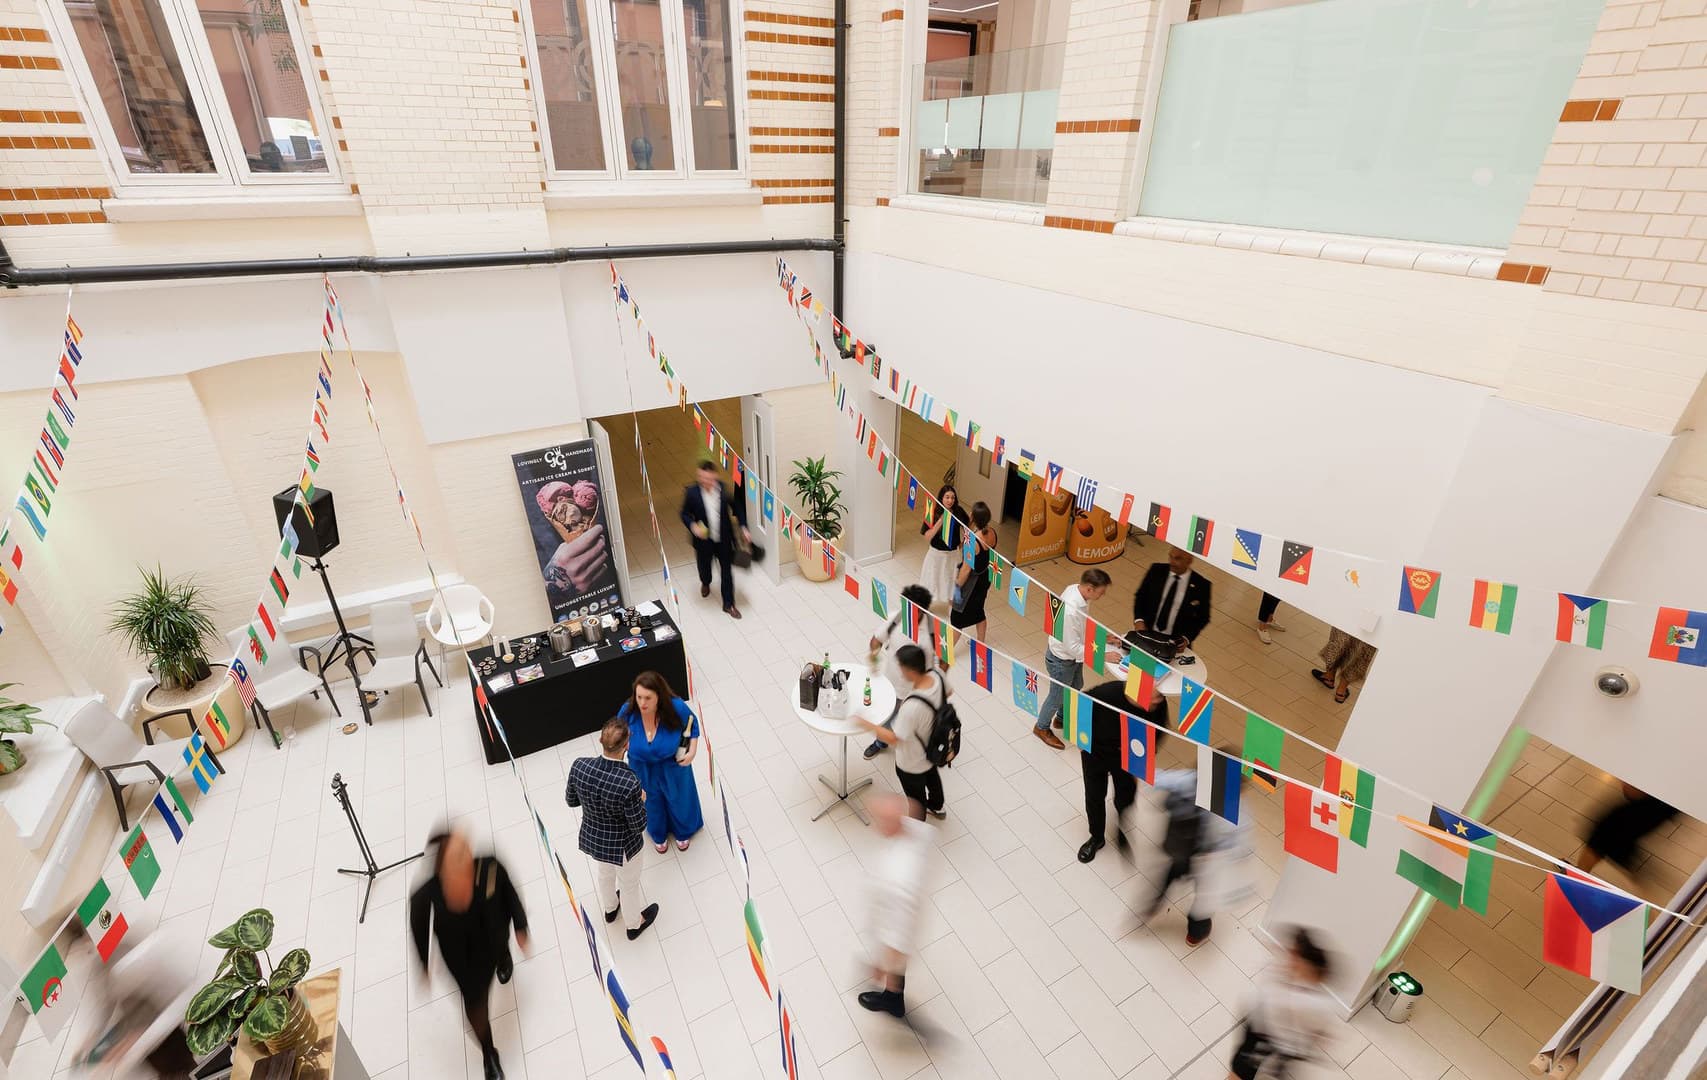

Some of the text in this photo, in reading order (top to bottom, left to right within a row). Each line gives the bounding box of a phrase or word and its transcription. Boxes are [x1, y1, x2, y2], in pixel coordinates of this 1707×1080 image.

[517, 458, 542, 467] LOVINGLY
[565, 447, 593, 457] HANDMADE
[522, 477, 545, 485] ARTISAN
[554, 470, 572, 479] CREAM
[577, 465, 596, 474] SORBET
[554, 591, 597, 610] UNFORGETTABLE
[596, 583, 616, 595] LUXURY
